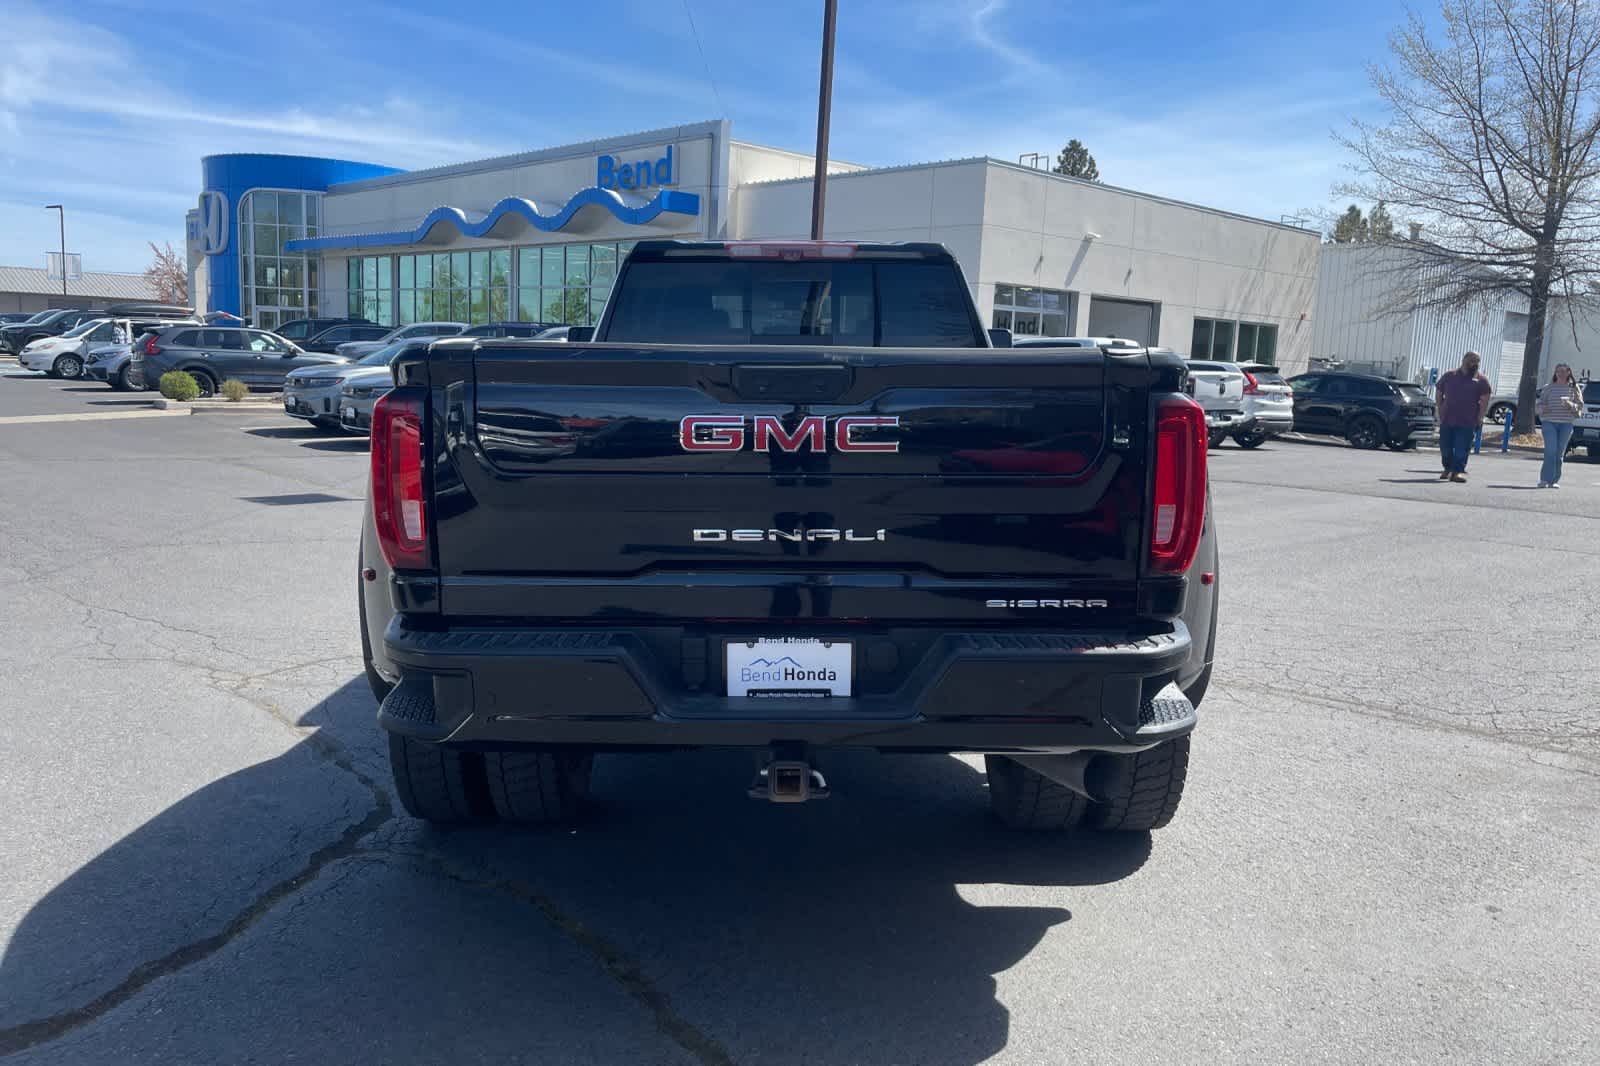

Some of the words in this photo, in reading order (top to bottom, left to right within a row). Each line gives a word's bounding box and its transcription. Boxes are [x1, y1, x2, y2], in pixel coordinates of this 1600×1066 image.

[598, 144, 673, 189] Bend
[679, 415, 900, 453] GMC
[693, 529, 886, 542] DENALI
[986, 599, 1108, 608] SIERRA
[741, 667, 781, 682] Bend
[784, 667, 837, 681] Honda
